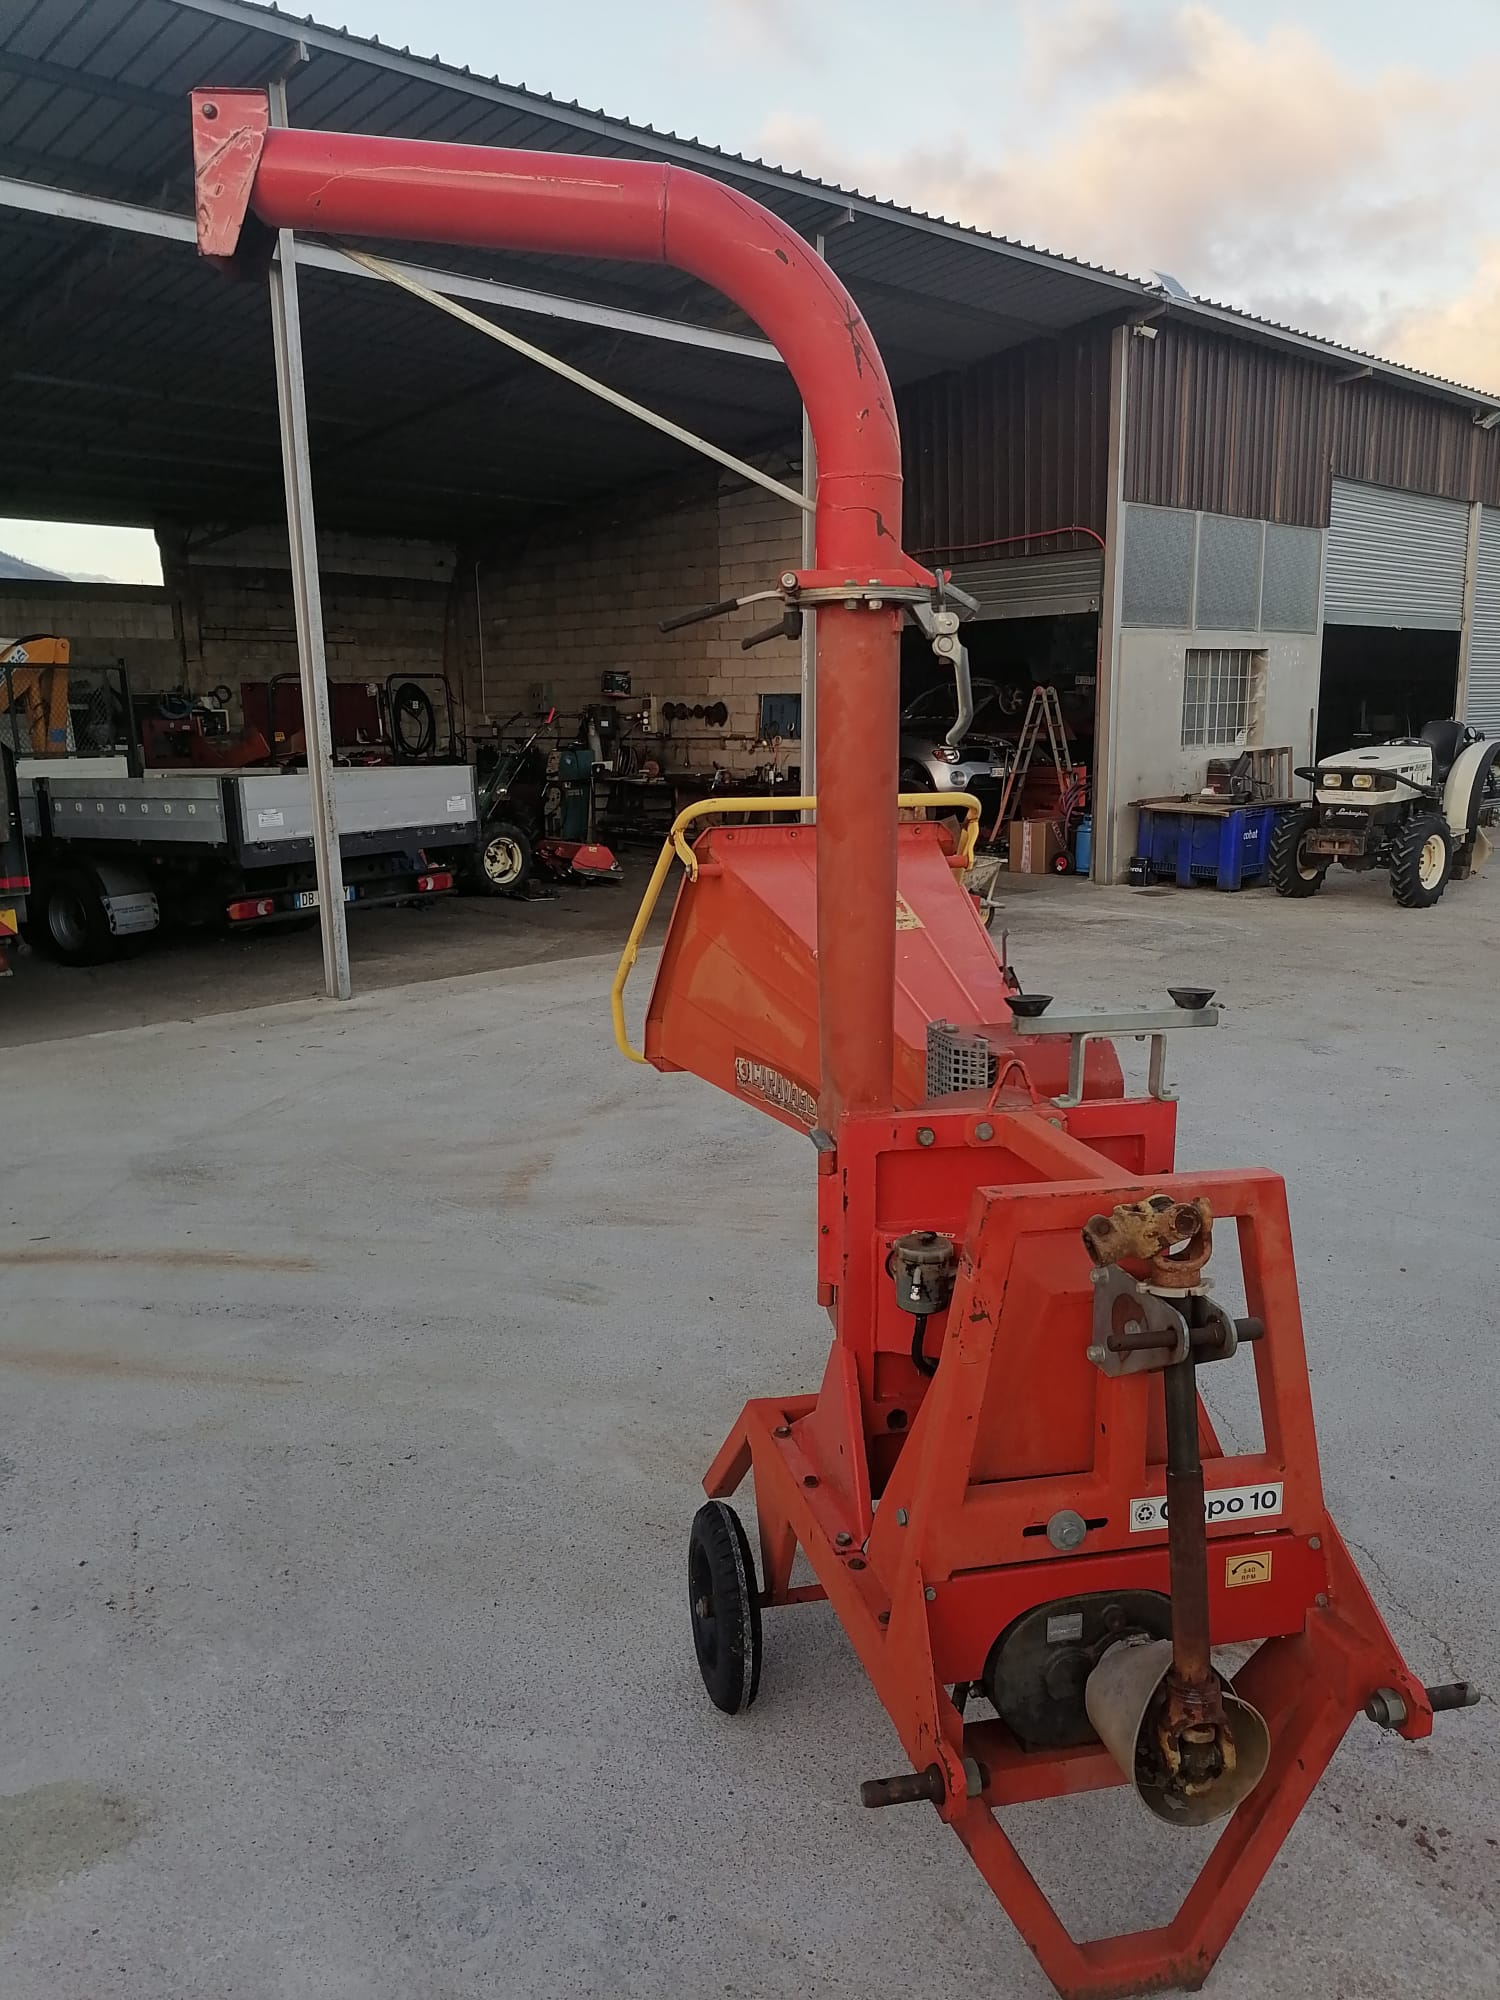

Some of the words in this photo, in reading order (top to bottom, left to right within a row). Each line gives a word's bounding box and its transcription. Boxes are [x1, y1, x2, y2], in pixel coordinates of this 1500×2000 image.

[302, 892, 314, 906] DB
[751, 1062, 817, 1116] CARAVAGG
[1249, 1490, 1277, 1510] 10
